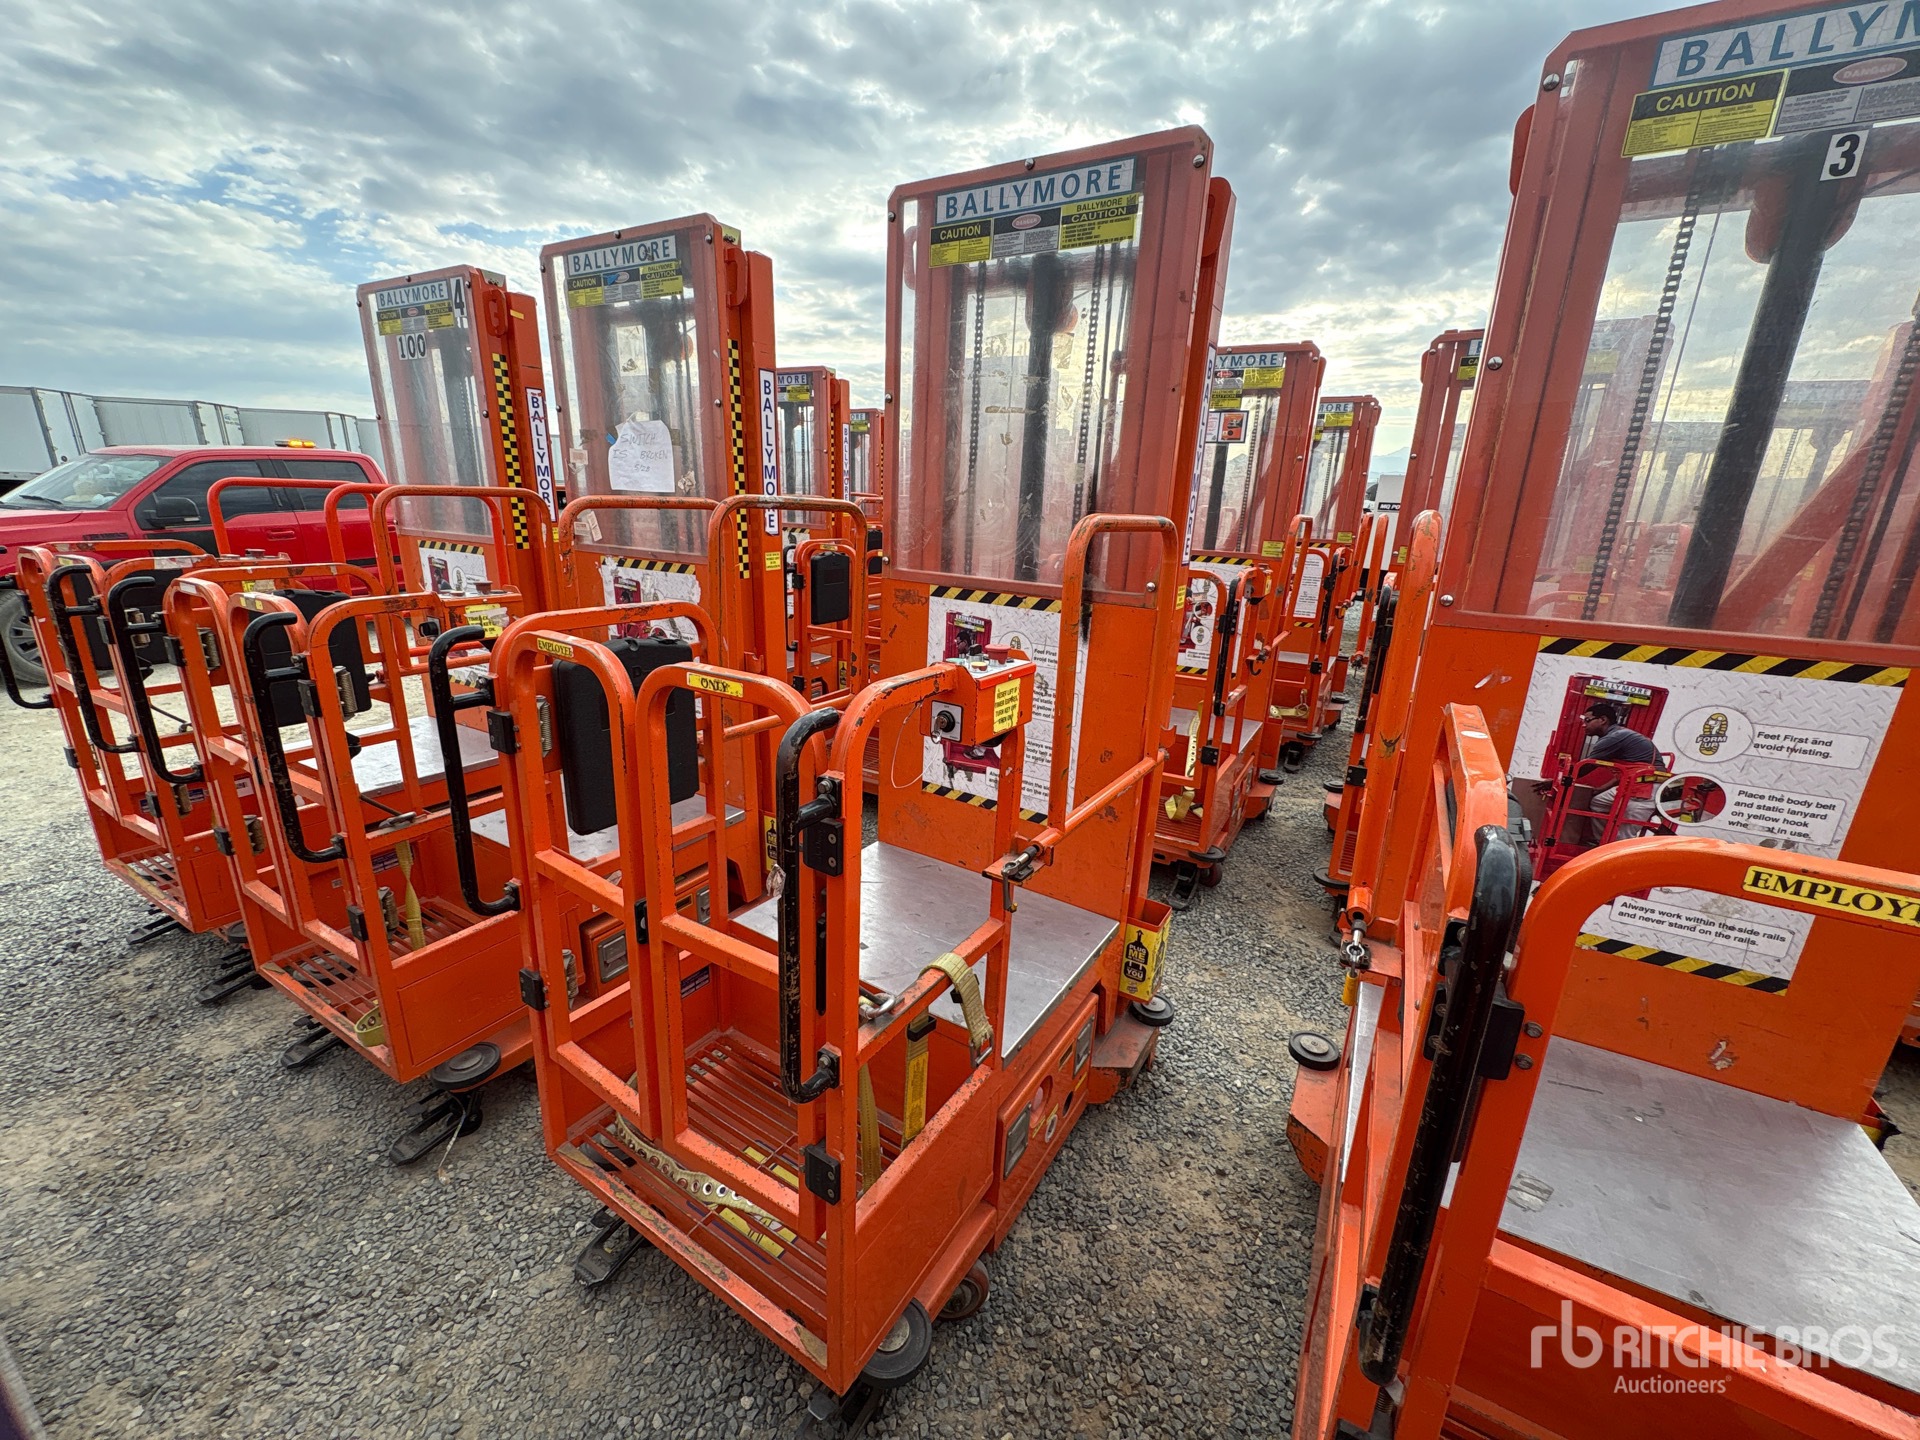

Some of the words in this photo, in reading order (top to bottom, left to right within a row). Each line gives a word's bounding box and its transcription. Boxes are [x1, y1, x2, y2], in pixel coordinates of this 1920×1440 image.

[1656, 82, 1756, 112] CAUTION
[1829, 133, 1860, 178] 3
[946, 164, 1122, 220] BALLYMORE
[1076, 198, 1123, 212] BALLYMORE
[1071, 207, 1127, 223] CAUTION
[940, 224, 981, 241] CAUTION
[573, 239, 670, 272] BALLYMORE
[572, 278, 597, 288] CAUTION
[646, 270, 676, 280] CAUTION
[380, 283, 444, 306] BALLYMORE
[454, 279, 464, 316] 4
[398, 334, 426, 358] 100
[620, 432, 656, 446] SWITCH
[531, 396, 551, 508] BALLYMOR
[613, 449, 628, 458] IS
[640, 450, 668, 460] BROKEN
[763, 380, 776, 528] BALLYMOE
[538, 640, 572, 656] EMPLOYEE
[700, 678, 728, 692] ONLY
[1592, 680, 1650, 694] BALLYMORE
[1696, 734, 1728, 744] FORM
[1756, 732, 1780, 741] Feet
[1782, 734, 1810, 744] First
[1811, 738, 1833, 747] and
[1754, 742, 1784, 752] avoid
[1785, 746, 1832, 760] twisting.
[1737, 790, 1766, 800] Place
[1768, 794, 1784, 803] the
[1786, 796, 1812, 808] body
[1816, 801, 1836, 811] belt
[1730, 810, 1744, 818] on
[1746, 812, 1780, 824] yellow
[1782, 817, 1809, 828] hook
[1734, 800, 1754, 808] and
[1756, 803, 1784, 814] static
[1786, 807, 1828, 821] lanyard
[1728, 820, 1751, 830] whe
[1777, 827, 1787, 835] in
[1790, 830, 1812, 840] use.
[1618, 911, 1636, 920] and
[1638, 916, 1666, 925] never
[1668, 920, 1696, 932] stand
[1698, 928, 1712, 936] on
[1714, 930, 1730, 940] the
[1734, 934, 1758, 946] rails.
[1620, 902, 1656, 914] Always
[1658, 910, 1682, 920] work
[1685, 916, 1716, 927] within
[1718, 922, 1736, 931] the
[1738, 926, 1760, 936] side
[1762, 931, 1786, 942] rails
[1128, 949, 1146, 960] ME
[1129, 944, 1146, 954] PLUG
[1126, 968, 1144, 978] YOU
